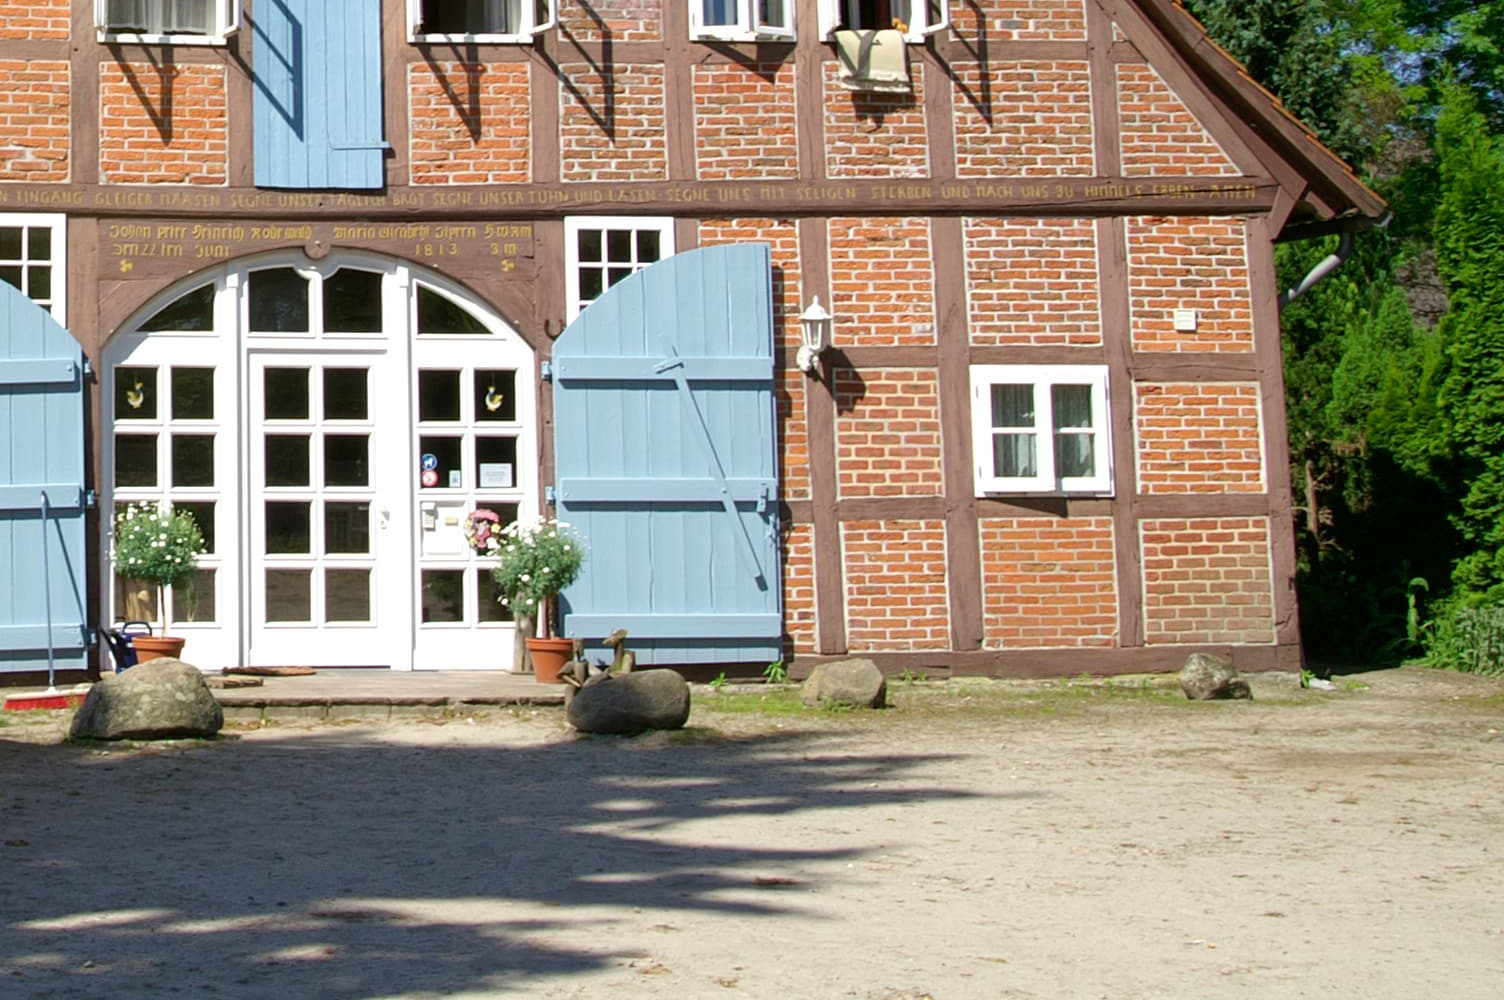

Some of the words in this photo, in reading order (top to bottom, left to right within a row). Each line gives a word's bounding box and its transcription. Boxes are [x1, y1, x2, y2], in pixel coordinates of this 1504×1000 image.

[16, 189, 82, 204] EINGANG
[230, 193, 273, 208] SEGNE
[392, 193, 425, 206] BROT
[432, 191, 474, 206] SEGNE
[480, 191, 524, 206] UNSER
[666, 187, 711, 202] SEGNE
[719, 187, 752, 202] UNS
[797, 185, 857, 201] SELIGEN
[871, 185, 932, 200] STERBEN
[941, 185, 970, 200] UND
[1021, 185, 1050, 199] UNS
